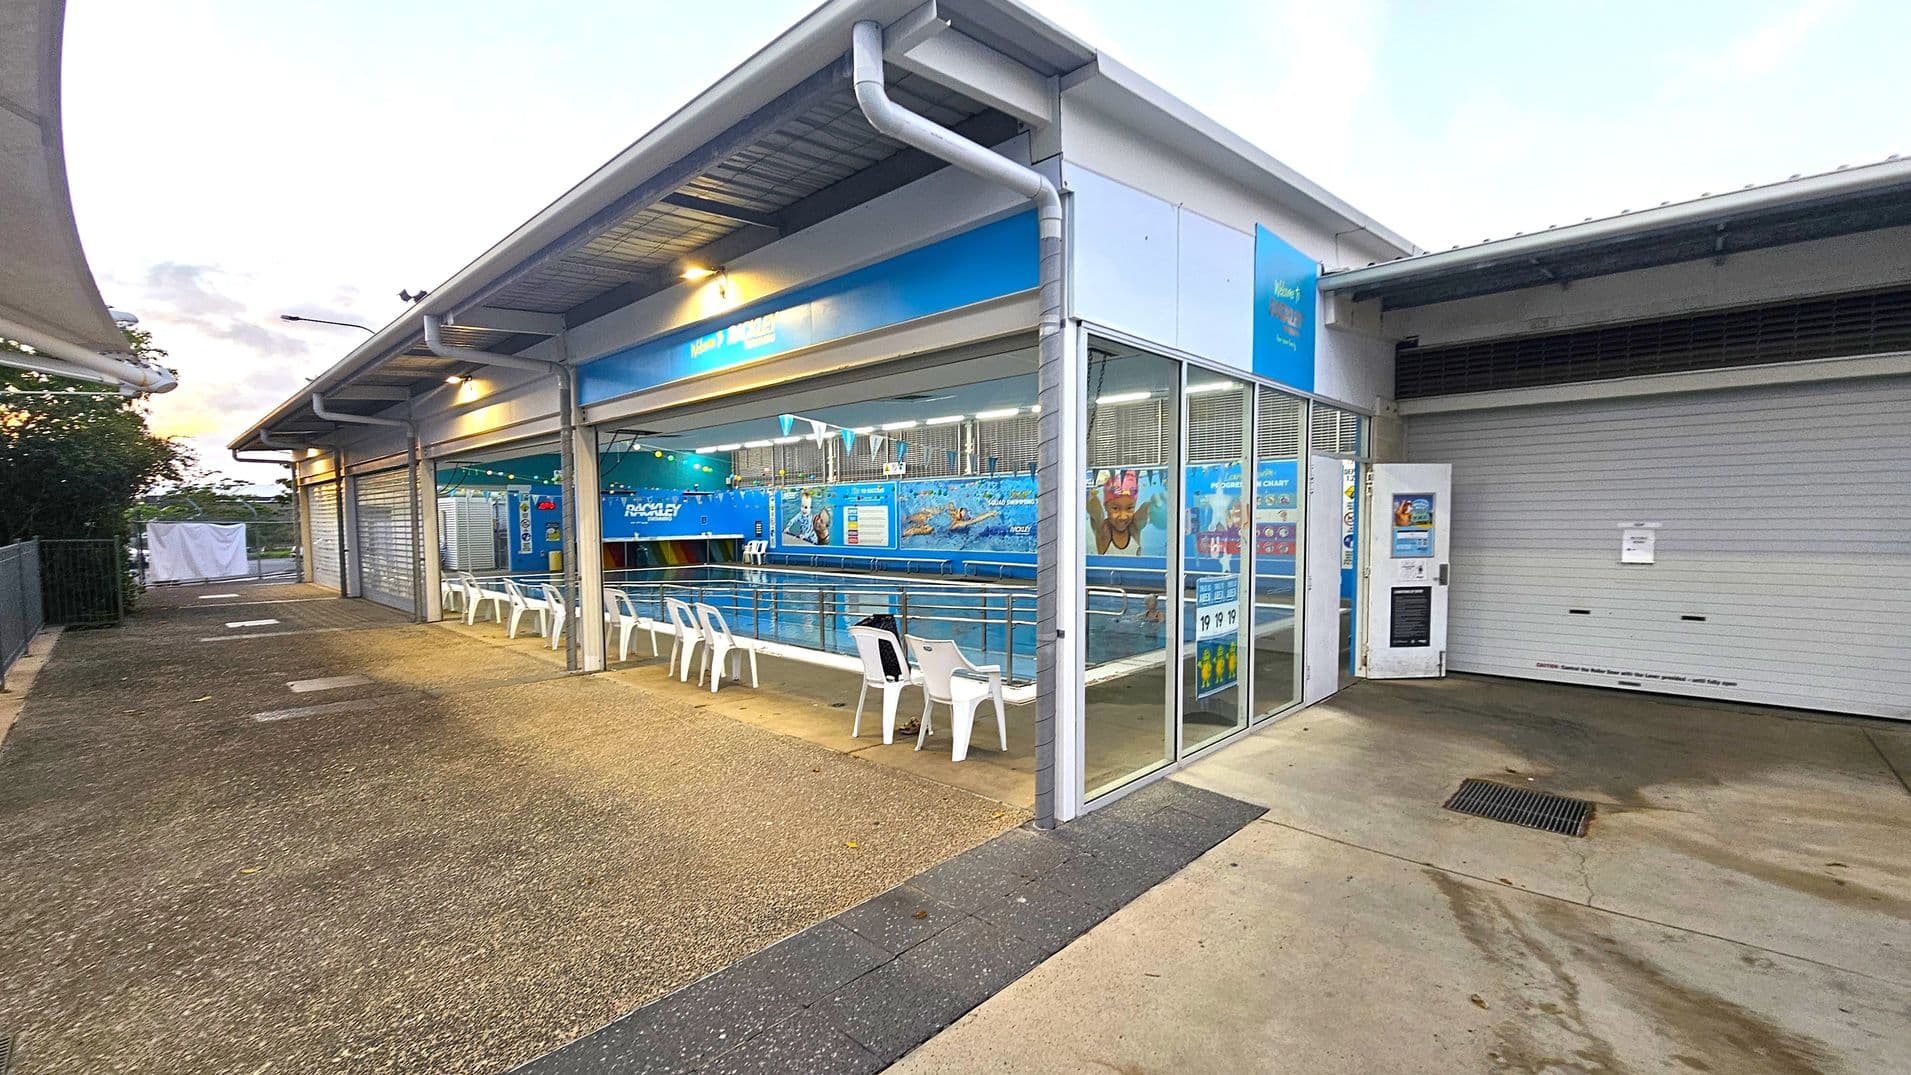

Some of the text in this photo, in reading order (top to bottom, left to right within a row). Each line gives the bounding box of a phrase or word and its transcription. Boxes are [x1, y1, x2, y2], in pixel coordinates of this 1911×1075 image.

[624, 502, 682, 517] RACKLEY
[1200, 609, 1236, 631] 19 19 19
